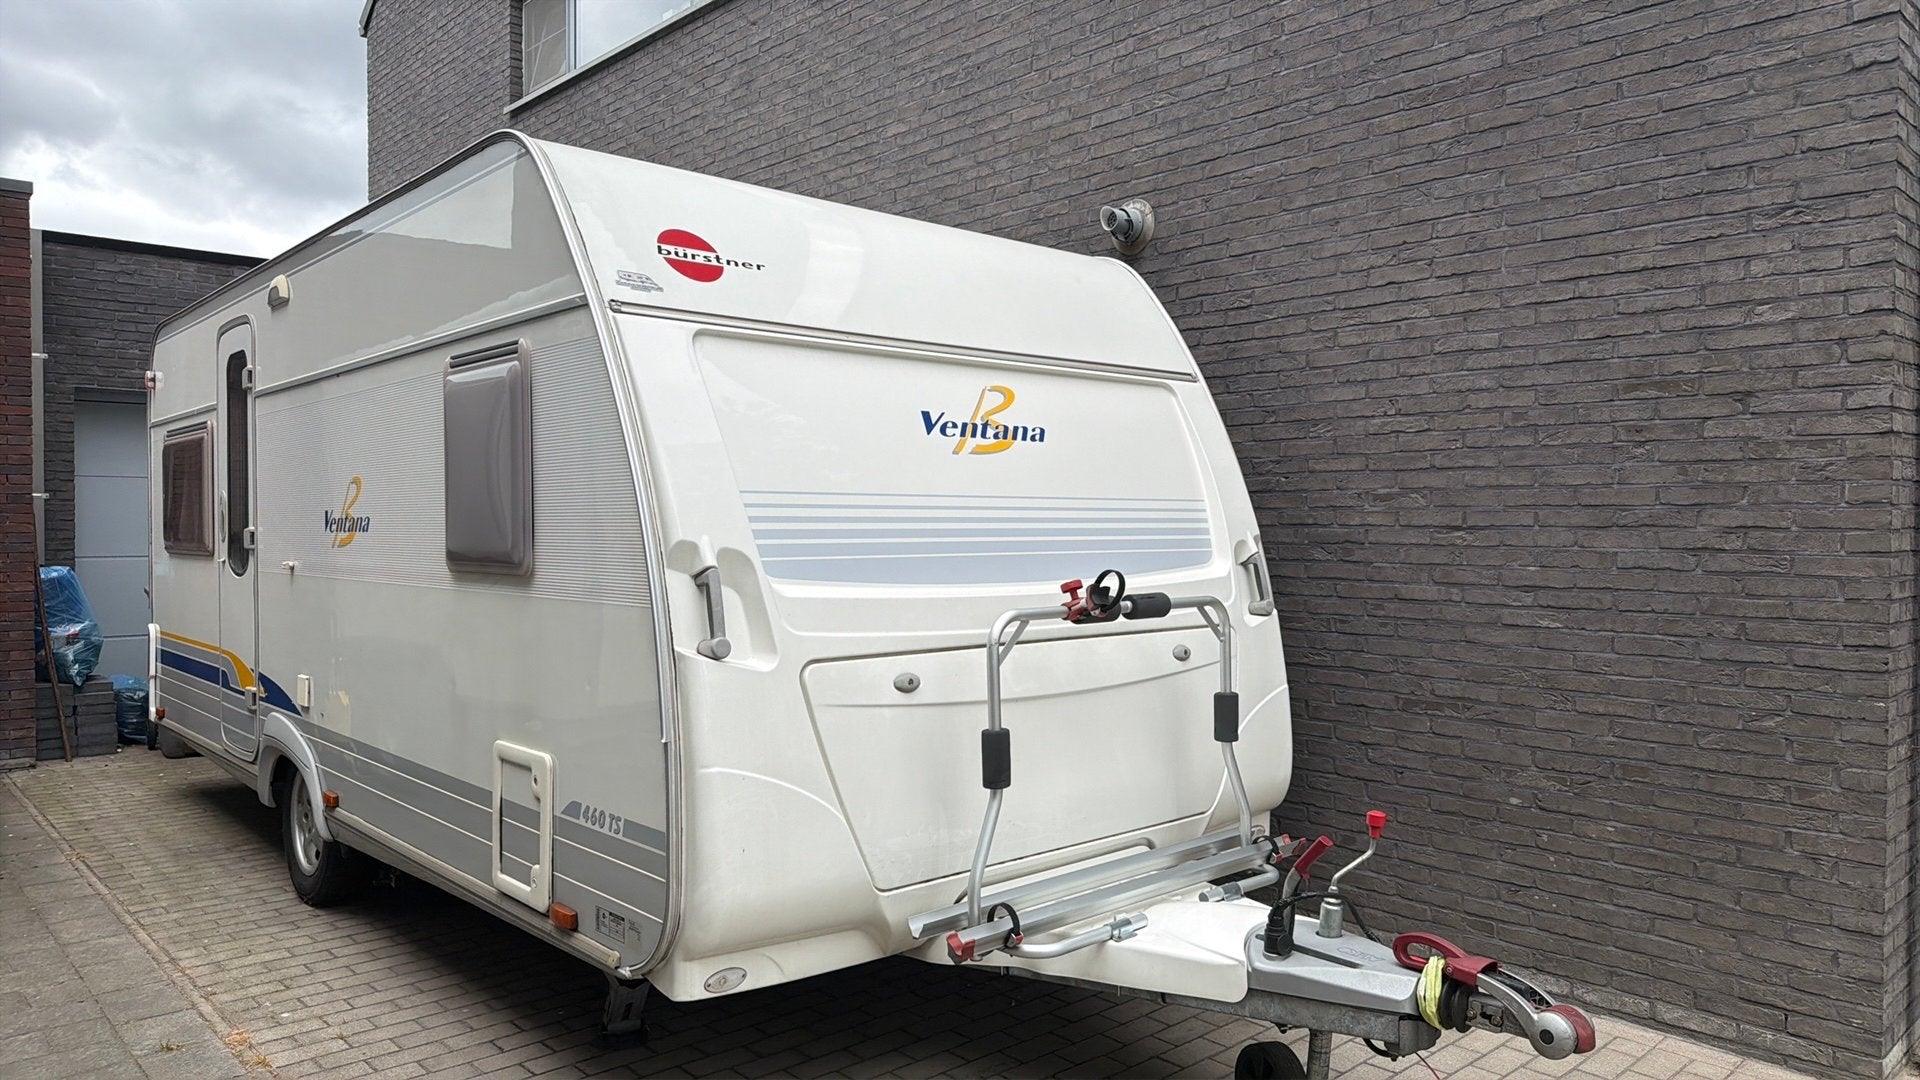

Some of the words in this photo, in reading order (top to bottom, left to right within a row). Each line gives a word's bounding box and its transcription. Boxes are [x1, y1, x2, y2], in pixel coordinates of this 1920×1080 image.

[657, 244, 766, 271] bürstner
[920, 410, 1046, 443] Ventana
[324, 509, 371, 533] Ventana
[582, 804, 606, 829] 460
[608, 812, 622, 835] TS
